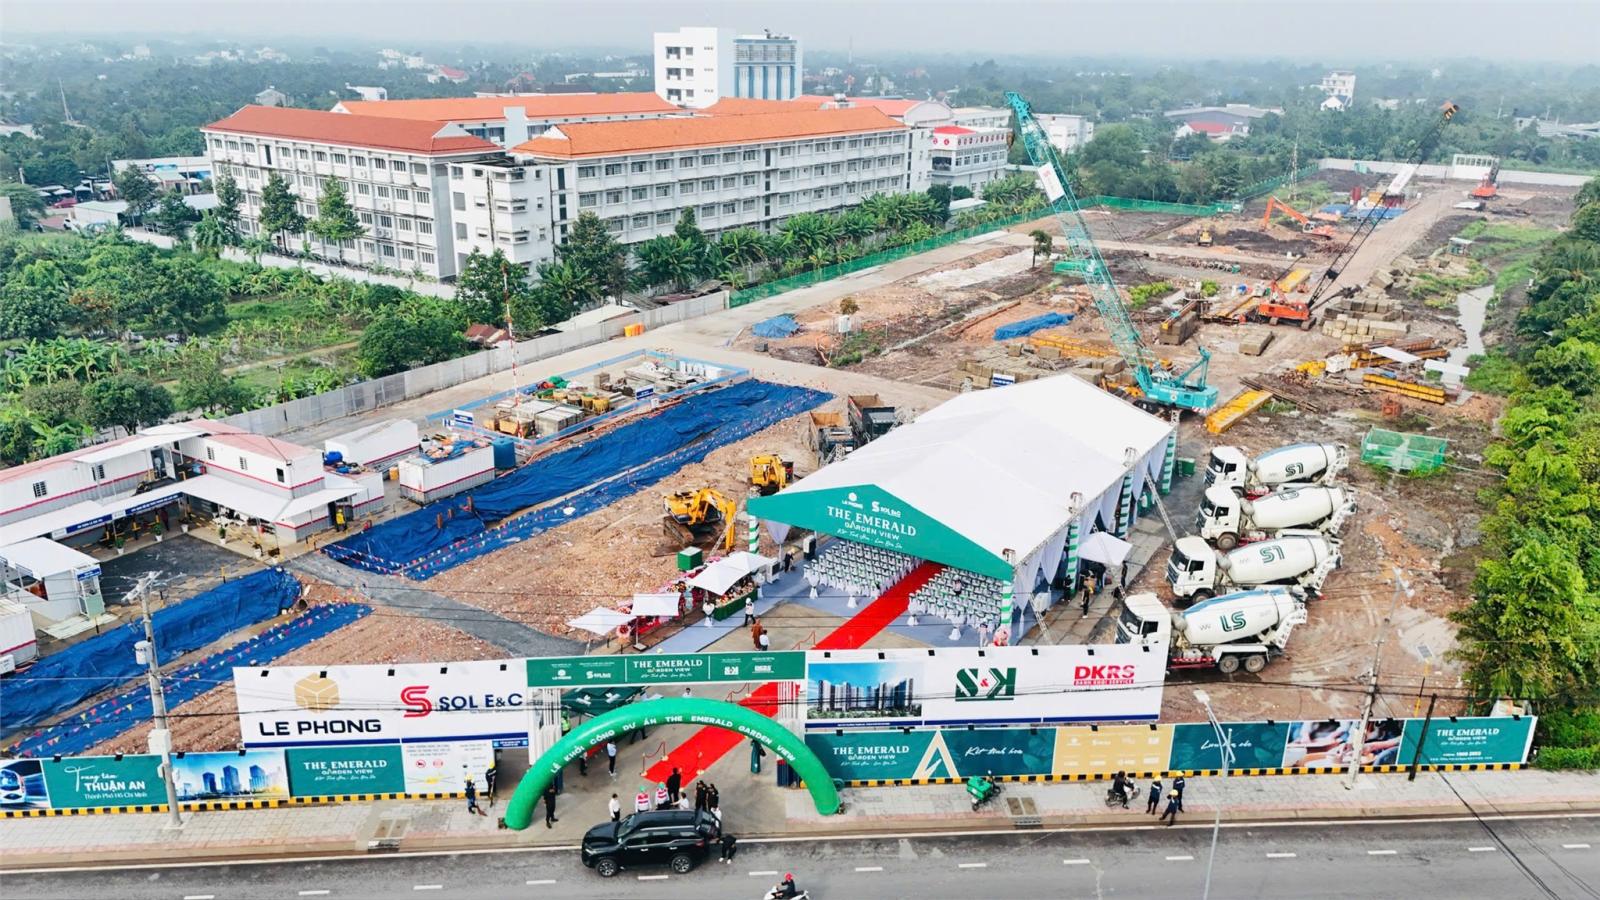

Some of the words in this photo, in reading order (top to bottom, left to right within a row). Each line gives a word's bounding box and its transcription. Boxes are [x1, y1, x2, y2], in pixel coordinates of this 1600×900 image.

[1285, 462, 1304, 477] S1
[827, 506, 852, 520] THE
[855, 513, 917, 536] EMERALD
[844, 521, 877, 535] GARDEN
[879, 531, 900, 540] VIEW
[1259, 545, 1285, 564] S1
[1220, 610, 1247, 632] LS
[633, 661, 653, 669] THE
[656, 659, 703, 668] EMERALD
[1074, 665, 1135, 679] DKRS
[439, 695, 478, 711] SOL
[485, 693, 523, 708] E&C
[259, 721, 290, 736] LE
[297, 719, 382, 735] PHONG
[1436, 729, 1455, 737] THE
[1456, 728, 1500, 736] EMERALD
[690, 715, 733, 727] EMERALD
[738, 725, 773, 745] GARDEN
[776, 744, 796, 762] VIEW
[833, 746, 854, 755] THE
[857, 745, 910, 754] EMERALD
[303, 761, 327, 770] THE
[331, 759, 388, 769] EMERALD
[84, 780, 126, 793] THUẬN
[129, 780, 146, 790] AN
